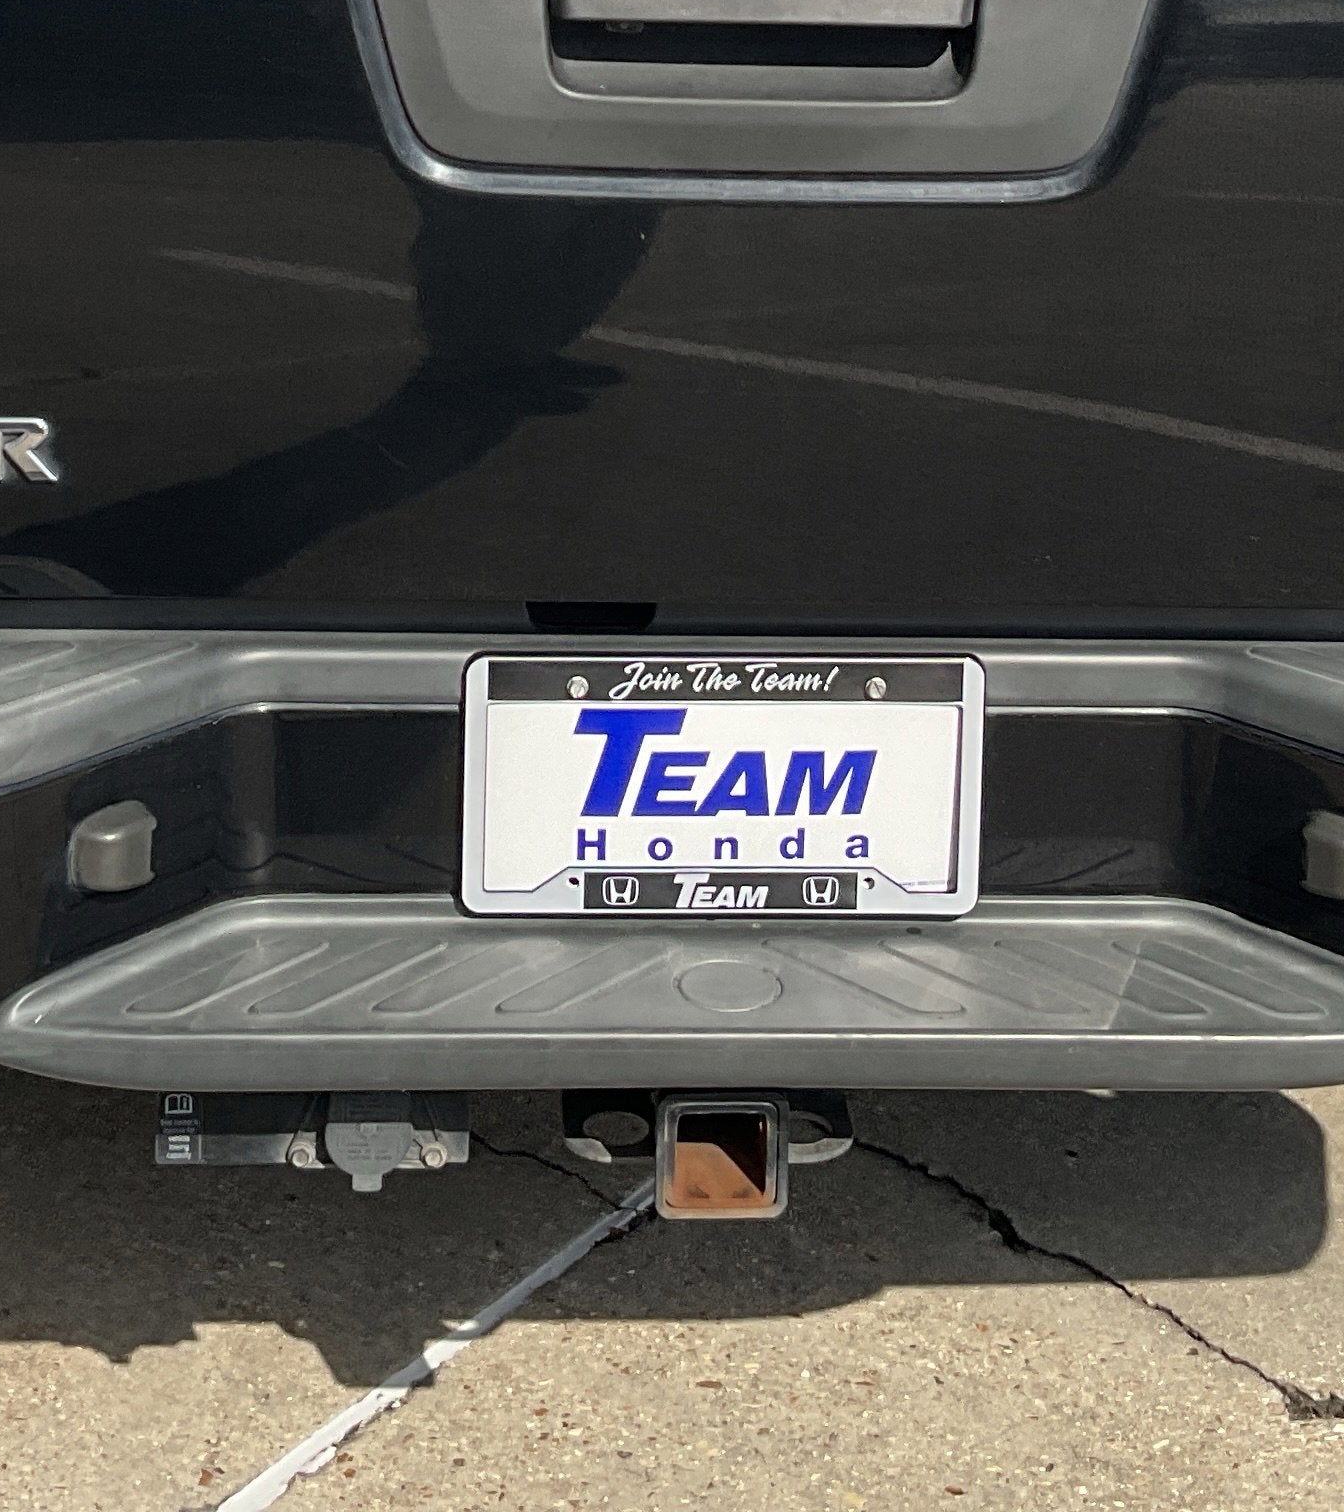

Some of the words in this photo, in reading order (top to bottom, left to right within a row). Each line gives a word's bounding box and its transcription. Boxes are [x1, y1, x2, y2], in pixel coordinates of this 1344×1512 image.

[608, 662, 683, 700] Join
[686, 662, 742, 693] The
[745, 662, 840, 694] Team!
[573, 708, 878, 817] TEAM
[576, 828, 870, 861] Honda
[672, 873, 769, 909] TEAM
